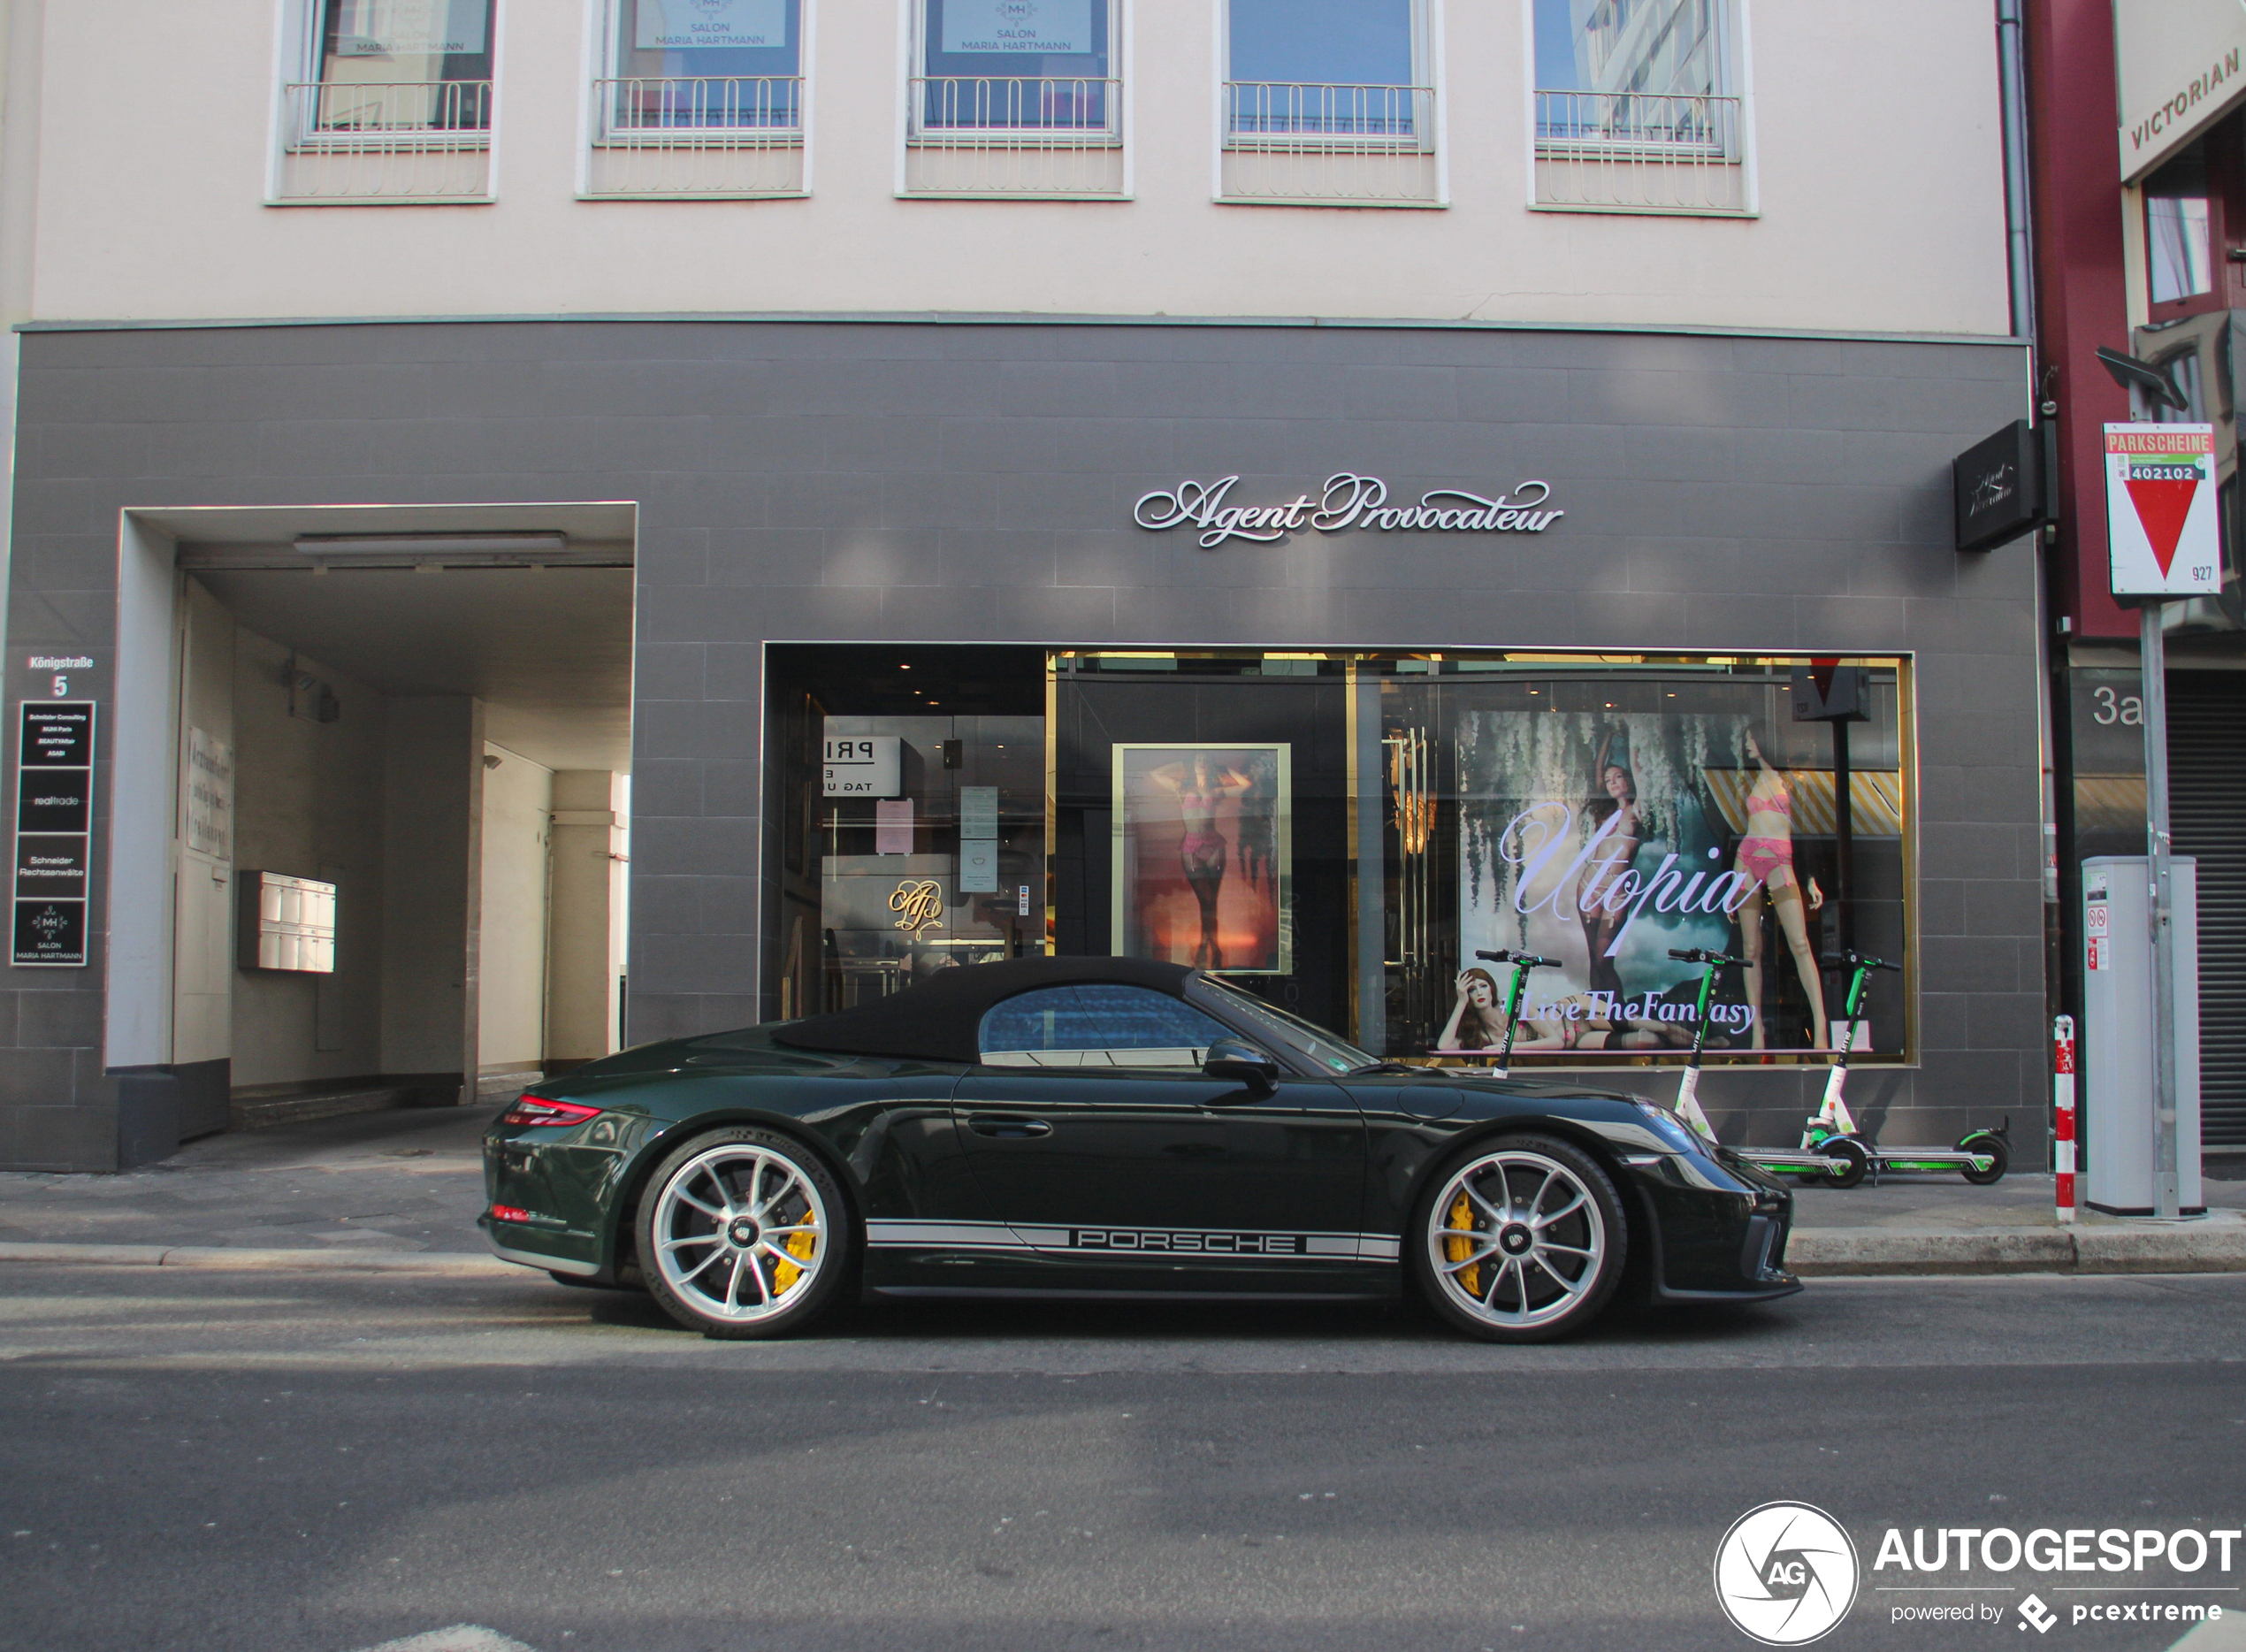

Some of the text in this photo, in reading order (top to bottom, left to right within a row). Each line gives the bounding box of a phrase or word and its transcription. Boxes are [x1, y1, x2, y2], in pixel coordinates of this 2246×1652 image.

[691, 23, 730, 32] SALON
[997, 29, 1036, 38] SALON
[697, 35, 765, 44] HARTMANN
[1003, 42, 1071, 50] HARTMANN
[356, 42, 464, 52] MARIA HARTMANN
[2131, 46, 2238, 150] VICTORIAN
[2108, 434, 2210, 452] PARKSCHEINE
[2132, 467, 2193, 480] 402102
[1134, 471, 1564, 547] Agent Provocateur
[2192, 566, 2212, 581] 927
[29, 657, 94, 670] Königstraße
[54, 676, 68, 697] 5
[2093, 686, 2144, 725] 3a
[34, 796, 79, 806] realtrade
[19, 868, 84, 876] Rechtsanwälte
[1500, 801, 1763, 958] Utopia
[42, 918, 57, 927] MH
[1499, 990, 1756, 1035] #LiveTheFanasy
[1077, 1230, 1295, 1252] PORSCHE
